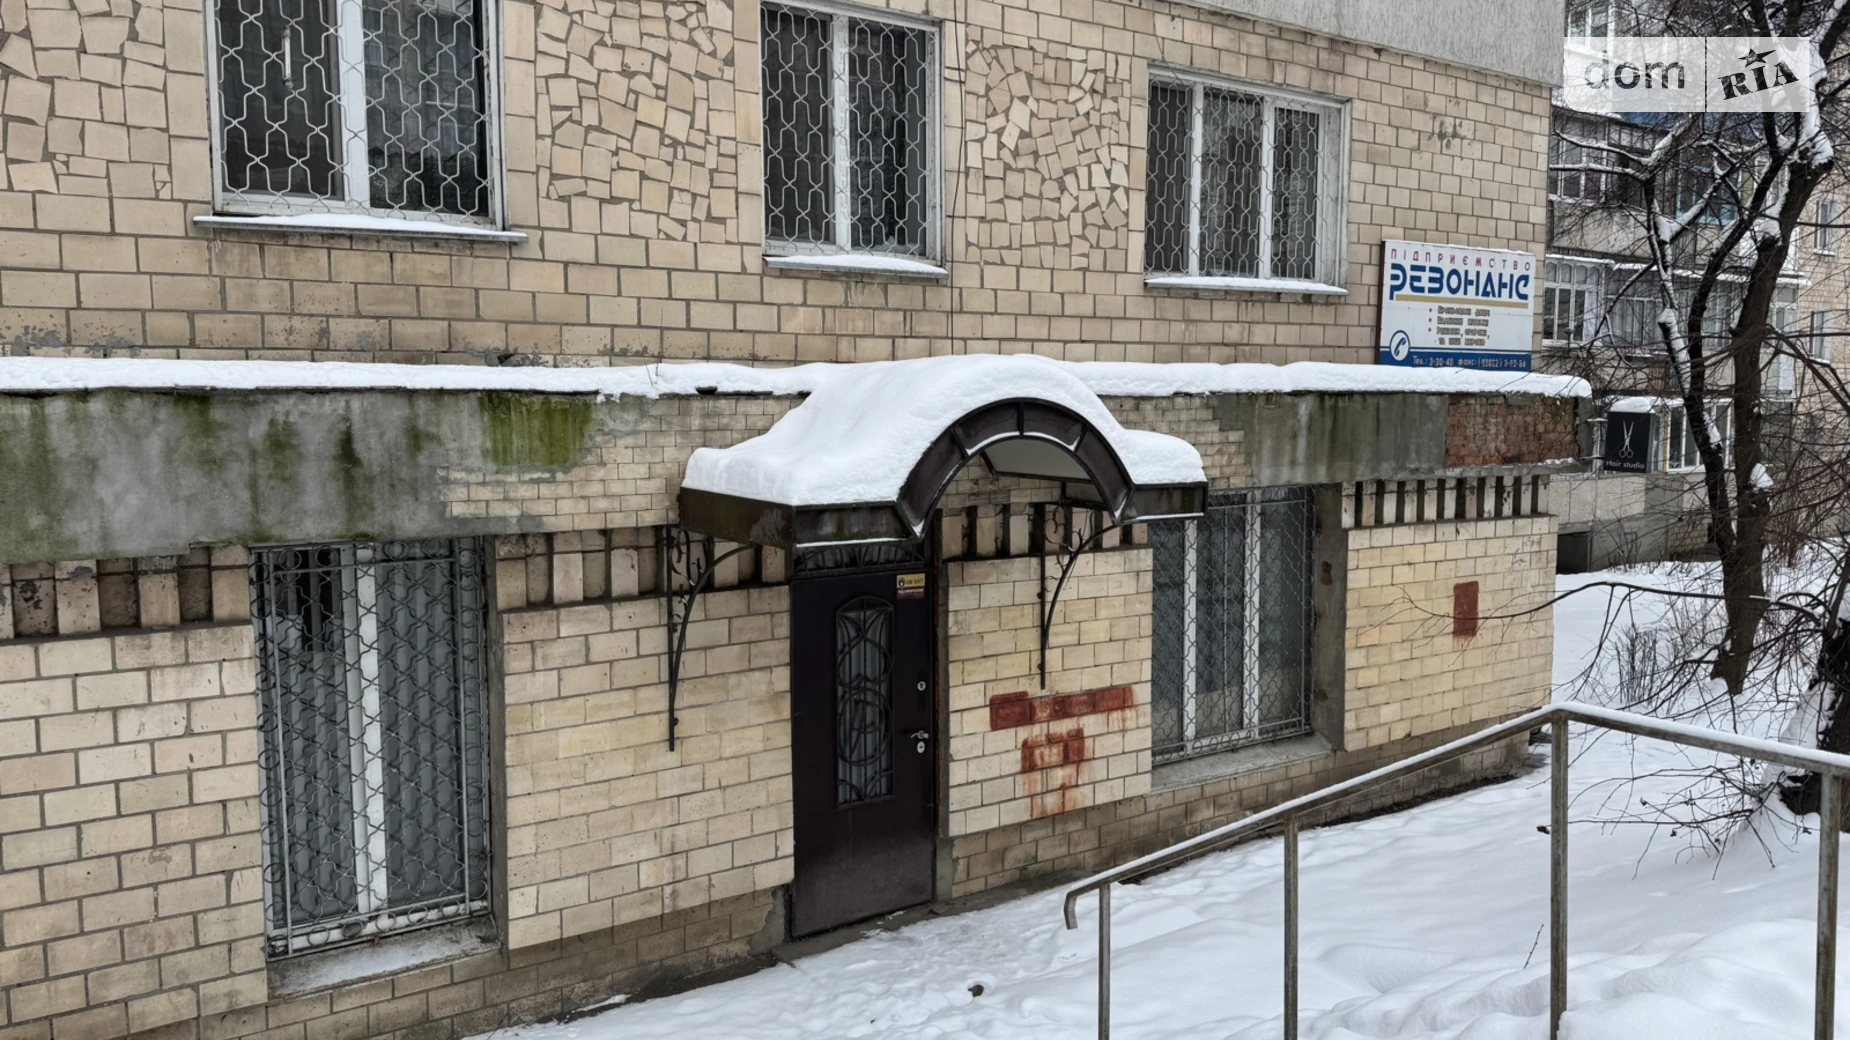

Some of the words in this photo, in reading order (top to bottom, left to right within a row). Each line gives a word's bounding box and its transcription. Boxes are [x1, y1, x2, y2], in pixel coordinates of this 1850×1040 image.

[1390, 248, 1531, 272] ПІДПРИЄМСТВО
[1389, 262, 1530, 300] РЕЗОНАНС
[1622, 461, 1645, 469] studio
